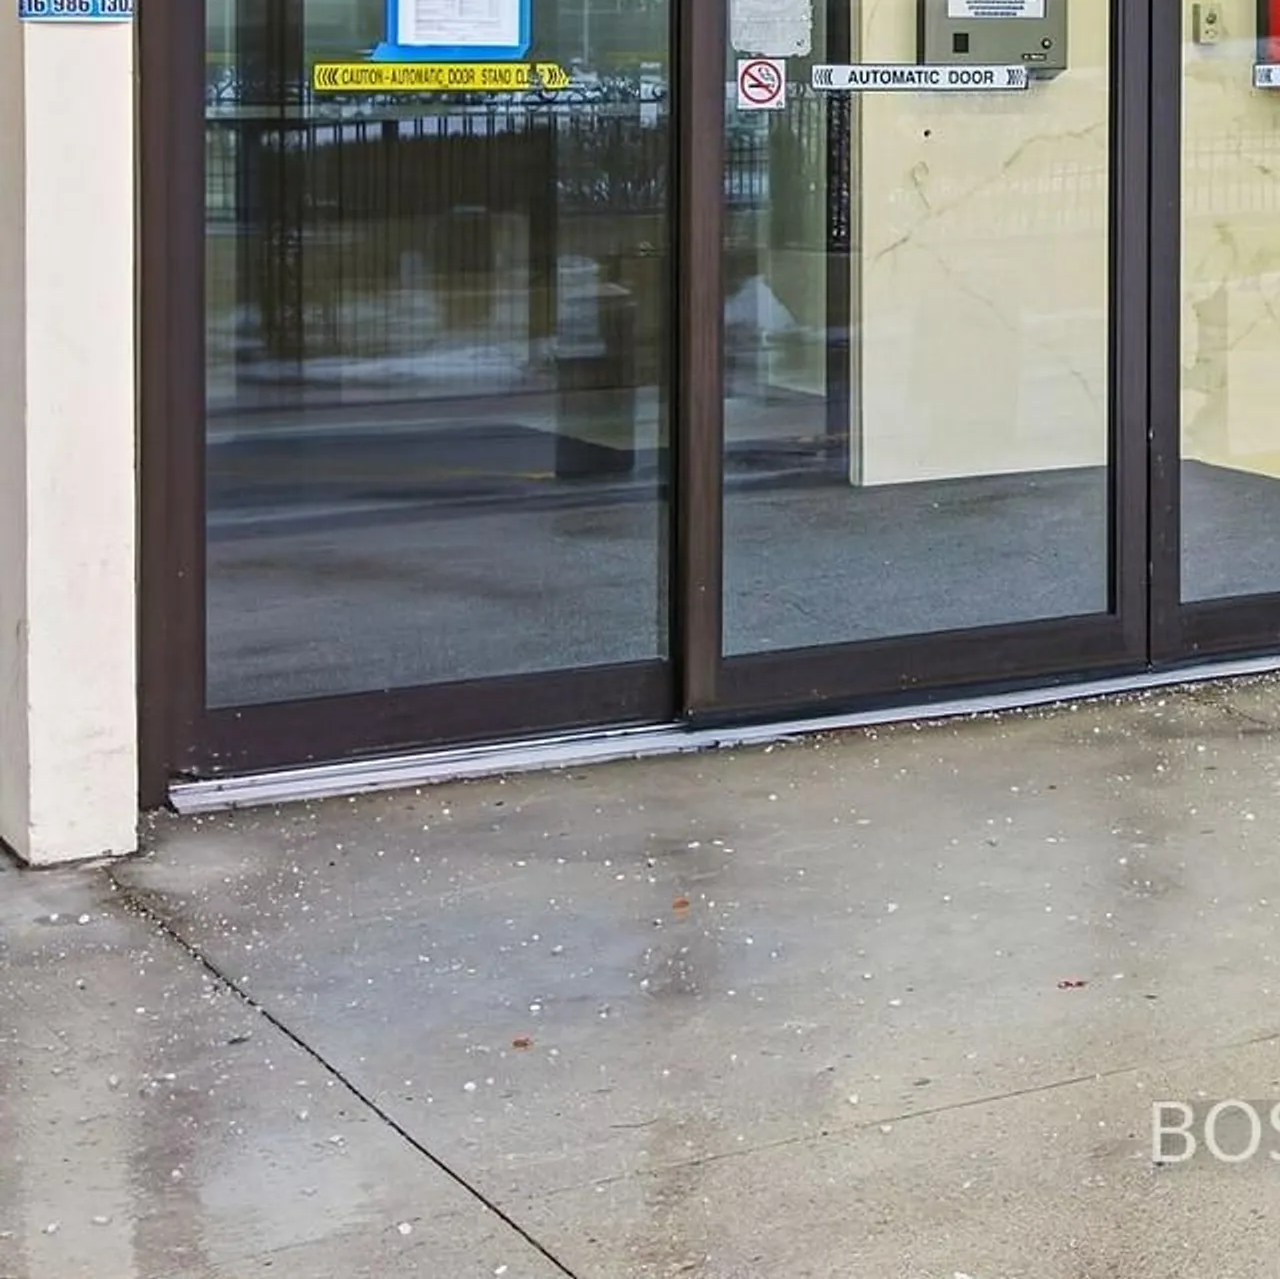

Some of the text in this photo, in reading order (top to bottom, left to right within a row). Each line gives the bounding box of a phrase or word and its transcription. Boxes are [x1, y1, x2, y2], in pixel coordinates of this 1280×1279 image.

[448, 67, 476, 85] DOOR
[481, 67, 511, 85] STAND
[848, 69, 994, 85] AUTOMATIC DOOR
